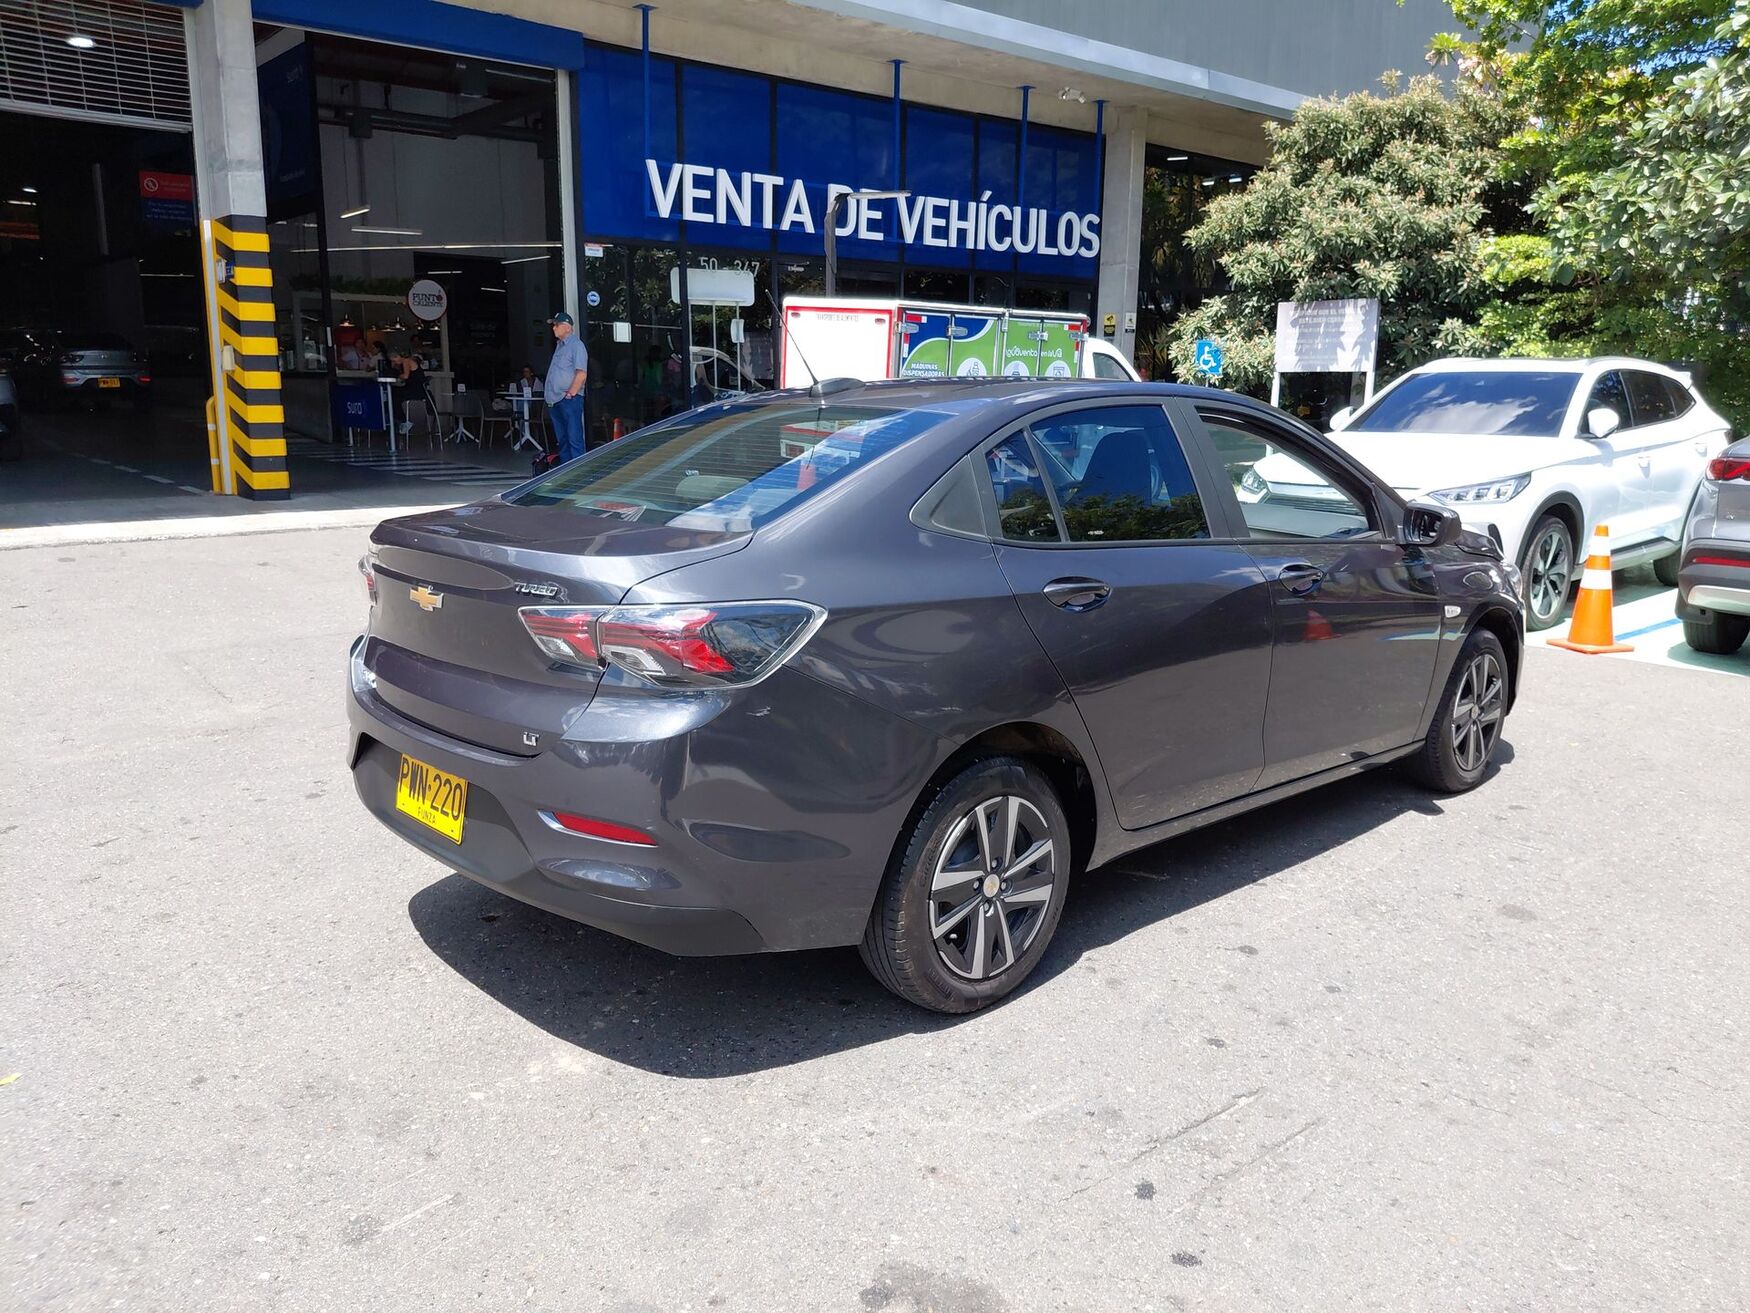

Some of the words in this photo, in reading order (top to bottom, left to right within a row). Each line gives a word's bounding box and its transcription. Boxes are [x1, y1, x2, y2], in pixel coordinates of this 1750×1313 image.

[645, 159, 815, 234] VENTA
[827, 183, 884, 241] DE
[897, 190, 1101, 258] VEHÍCULOS
[514, 582, 558, 596] TURBO
[523, 731, 540, 747] LT
